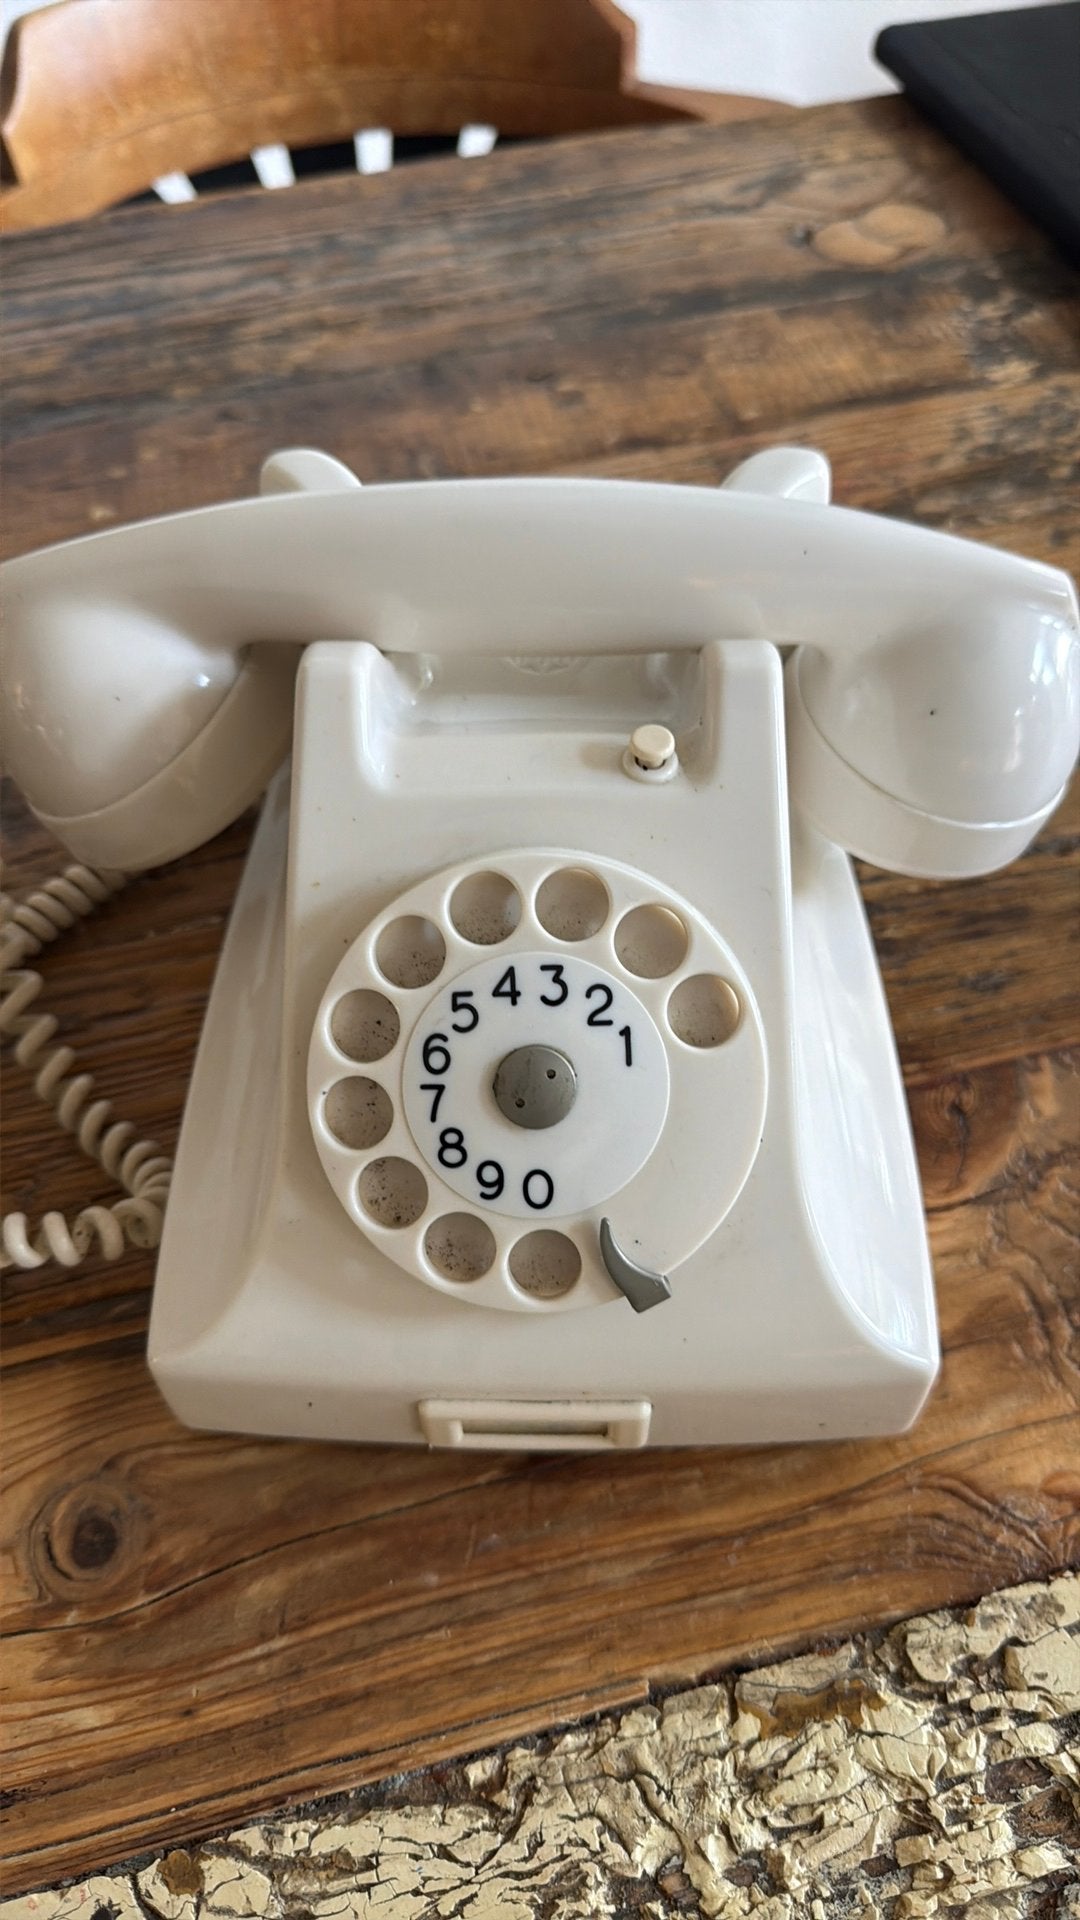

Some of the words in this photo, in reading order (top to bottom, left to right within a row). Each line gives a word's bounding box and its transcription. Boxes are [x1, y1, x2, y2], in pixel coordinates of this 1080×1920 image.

[491, 965, 522, 1007] 4
[539, 964, 569, 1008] 3
[585, 983, 614, 1027] 2
[450, 990, 480, 1034] 5
[421, 1032, 452, 1076] 6
[618, 1025, 633, 1067] 1
[419, 1083, 446, 1124] 7
[437, 1126, 468, 1170] 8
[475, 1159, 505, 1201] 9
[522, 1168, 555, 1210] 0
